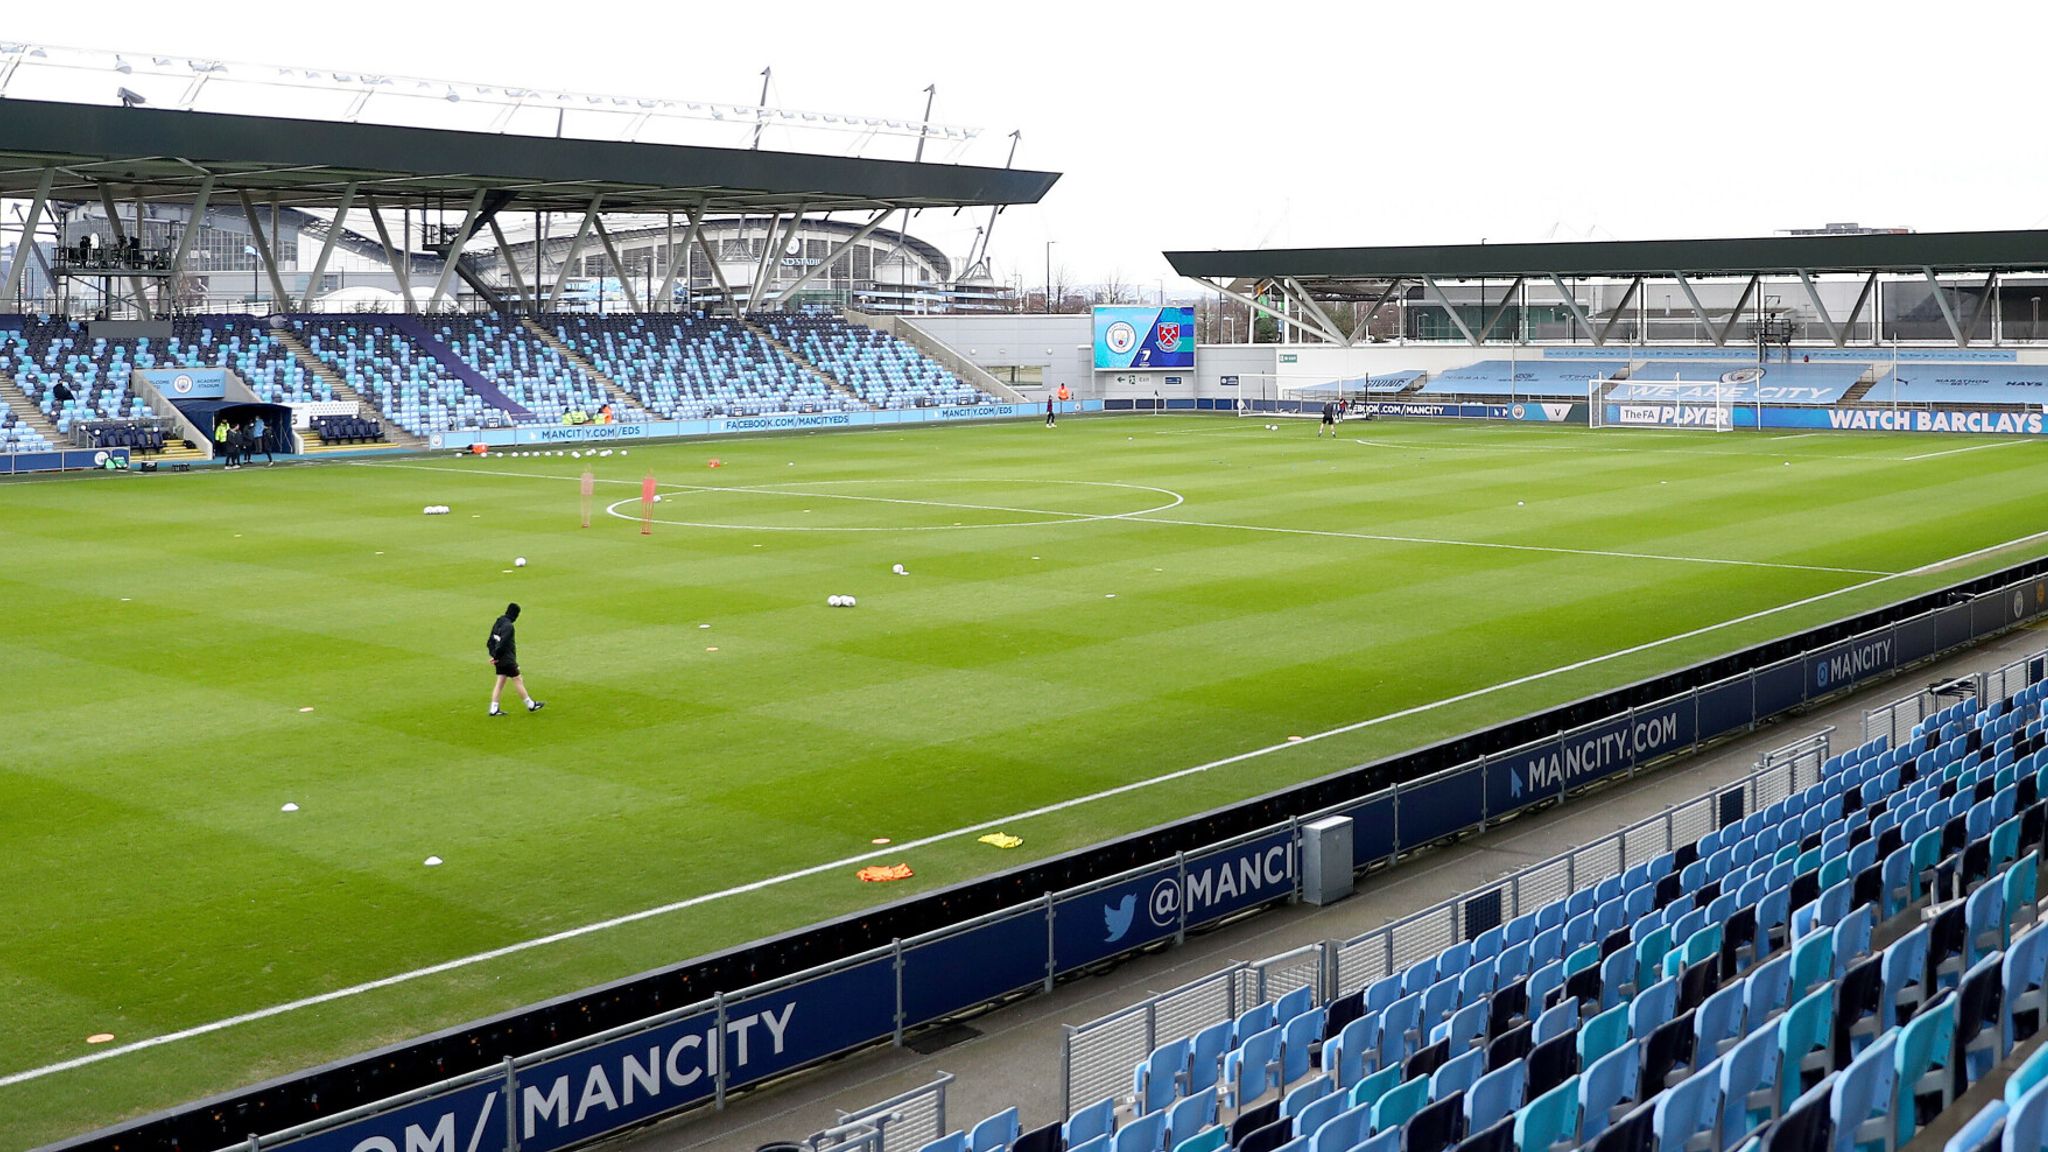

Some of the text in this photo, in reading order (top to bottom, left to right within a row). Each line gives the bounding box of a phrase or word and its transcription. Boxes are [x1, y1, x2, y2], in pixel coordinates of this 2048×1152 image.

[796, 258, 824, 266] STADIU
[1628, 386, 1833, 399] WE ARE CITY
[1554, 409, 1562, 417] V
[1660, 406, 1729, 425] PLAYER
[1828, 410, 2043, 433] WATCH BARCLAYS
[1830, 638, 1891, 683] MANCITY
[1528, 712, 1677, 793] MANCITY.COM
[1149, 838, 1304, 927] @MANCI
